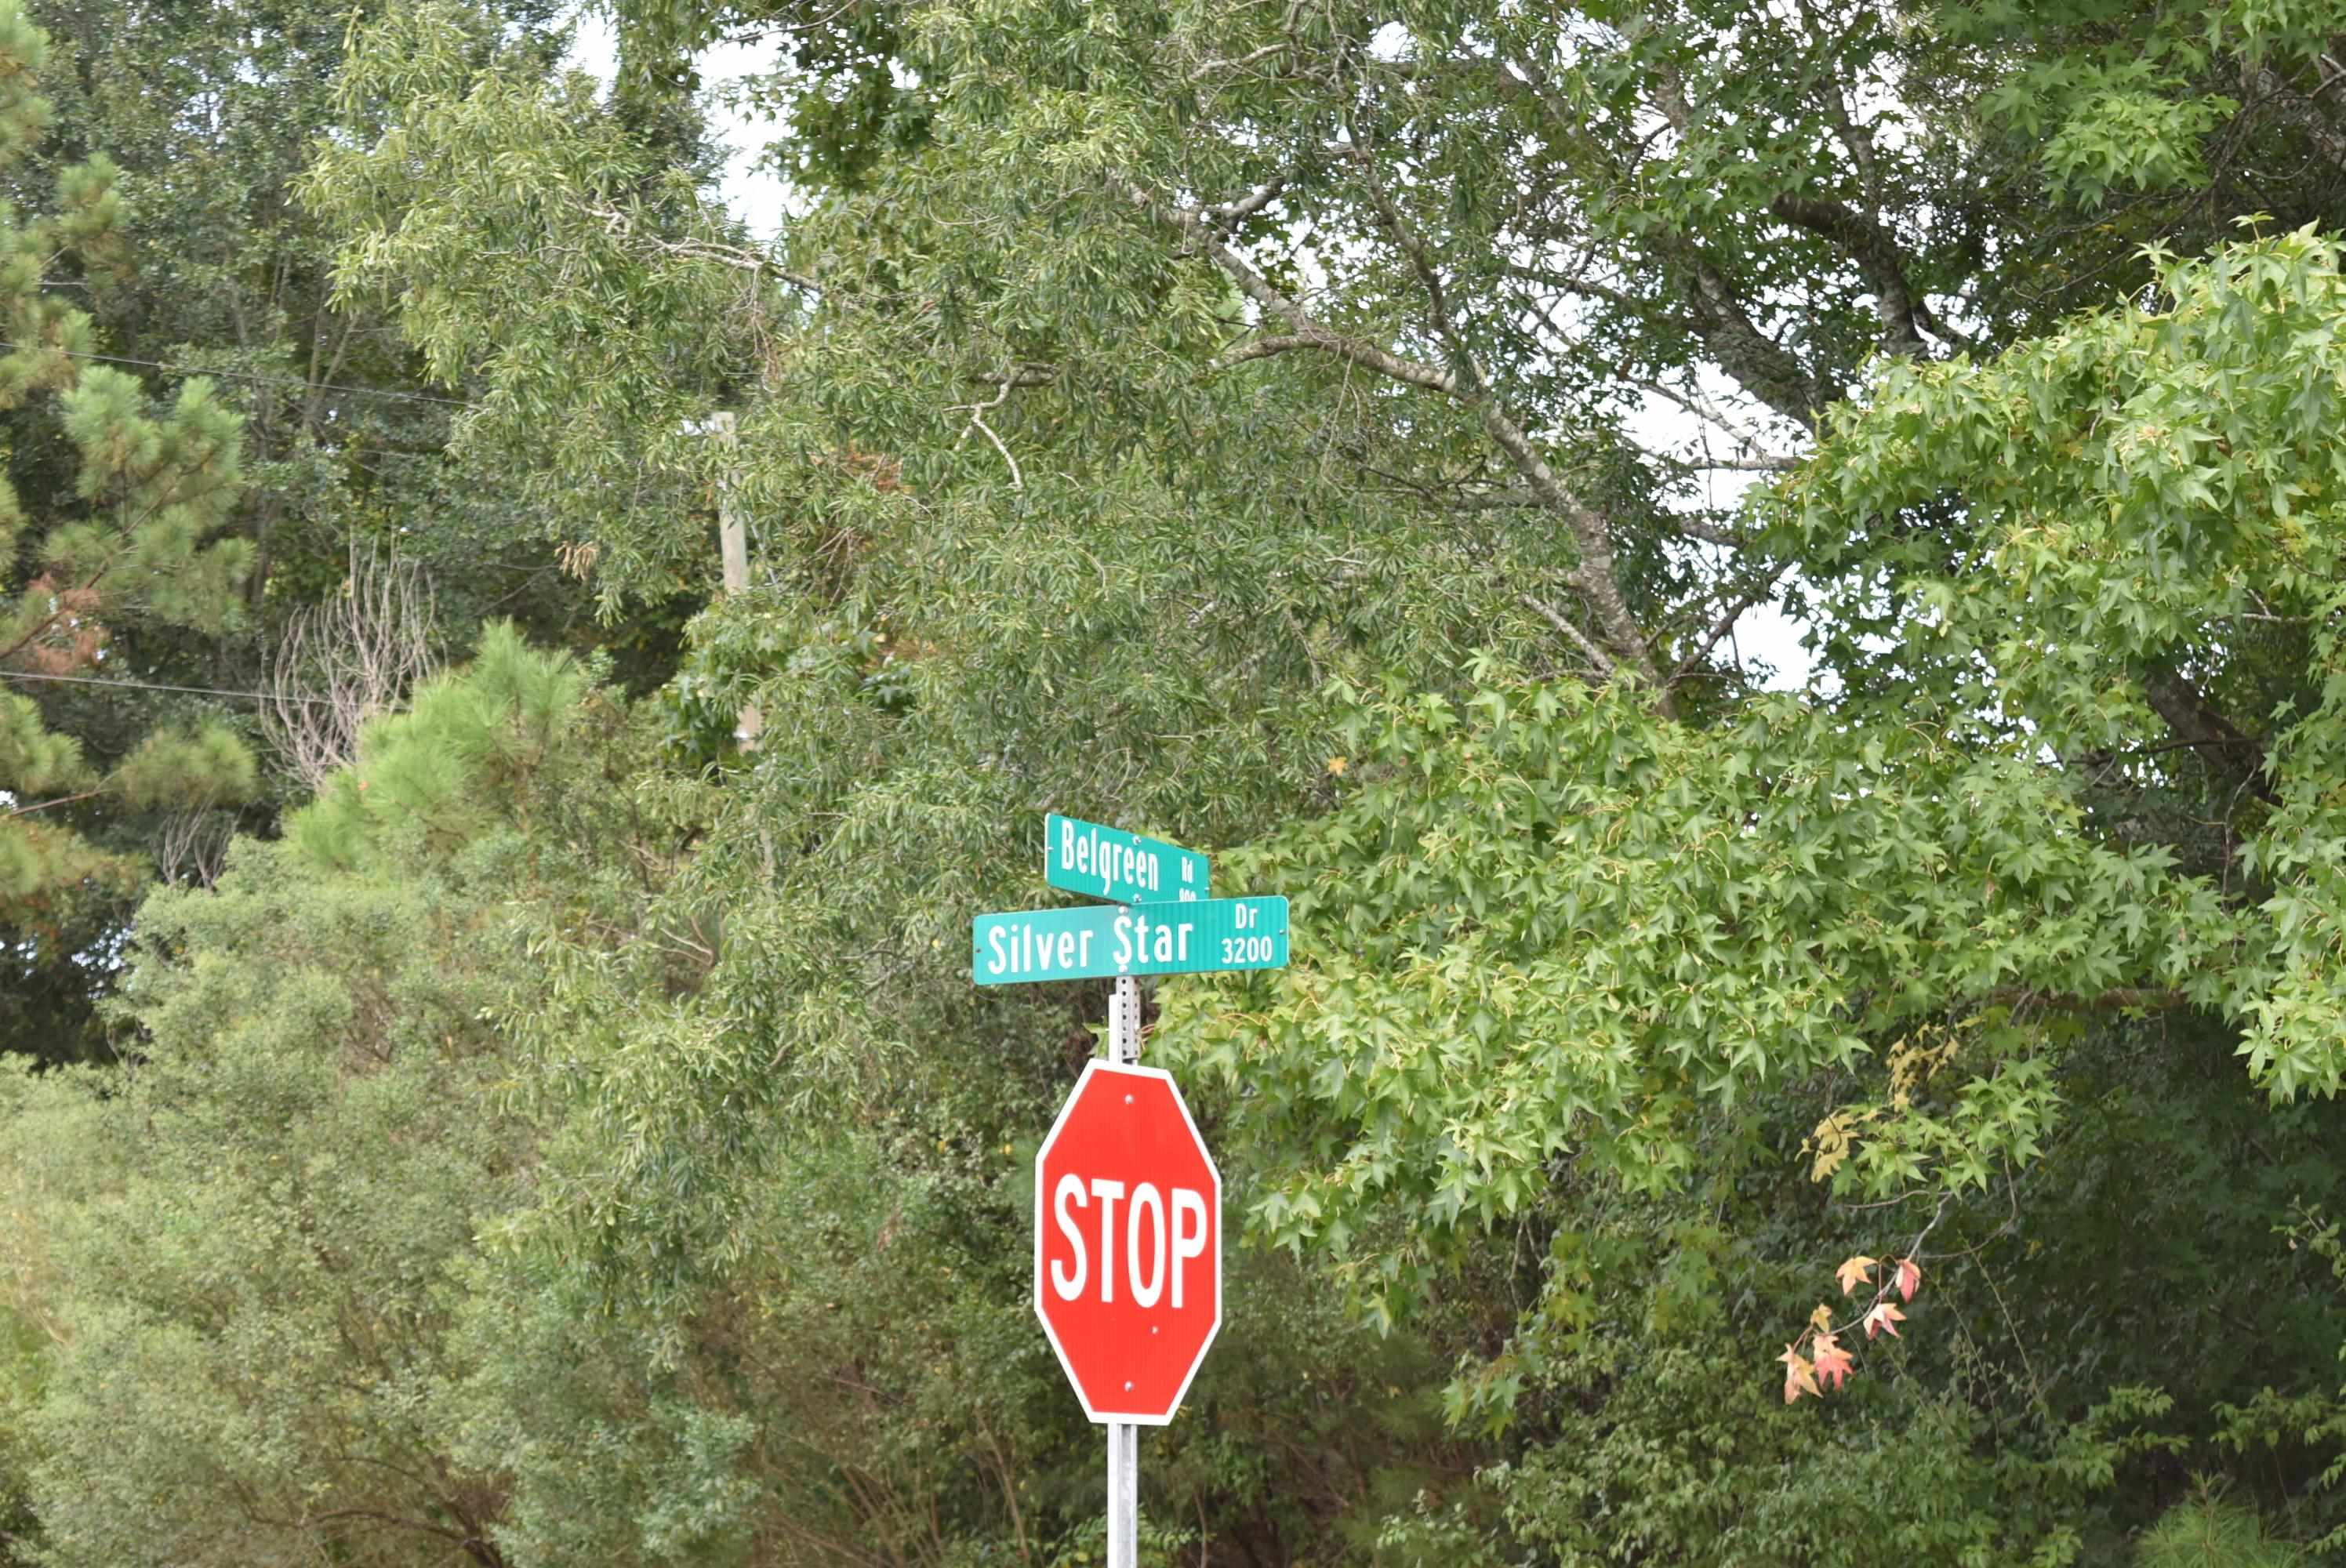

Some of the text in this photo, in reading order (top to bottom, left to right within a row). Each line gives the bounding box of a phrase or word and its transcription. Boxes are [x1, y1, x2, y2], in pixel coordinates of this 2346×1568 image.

[1061, 819, 1194, 896] Belgreen Rd
[987, 903, 1258, 975] Silver Star Dr
[1221, 935, 1273, 964] 3200
[1050, 1173, 1208, 1308] STOP
